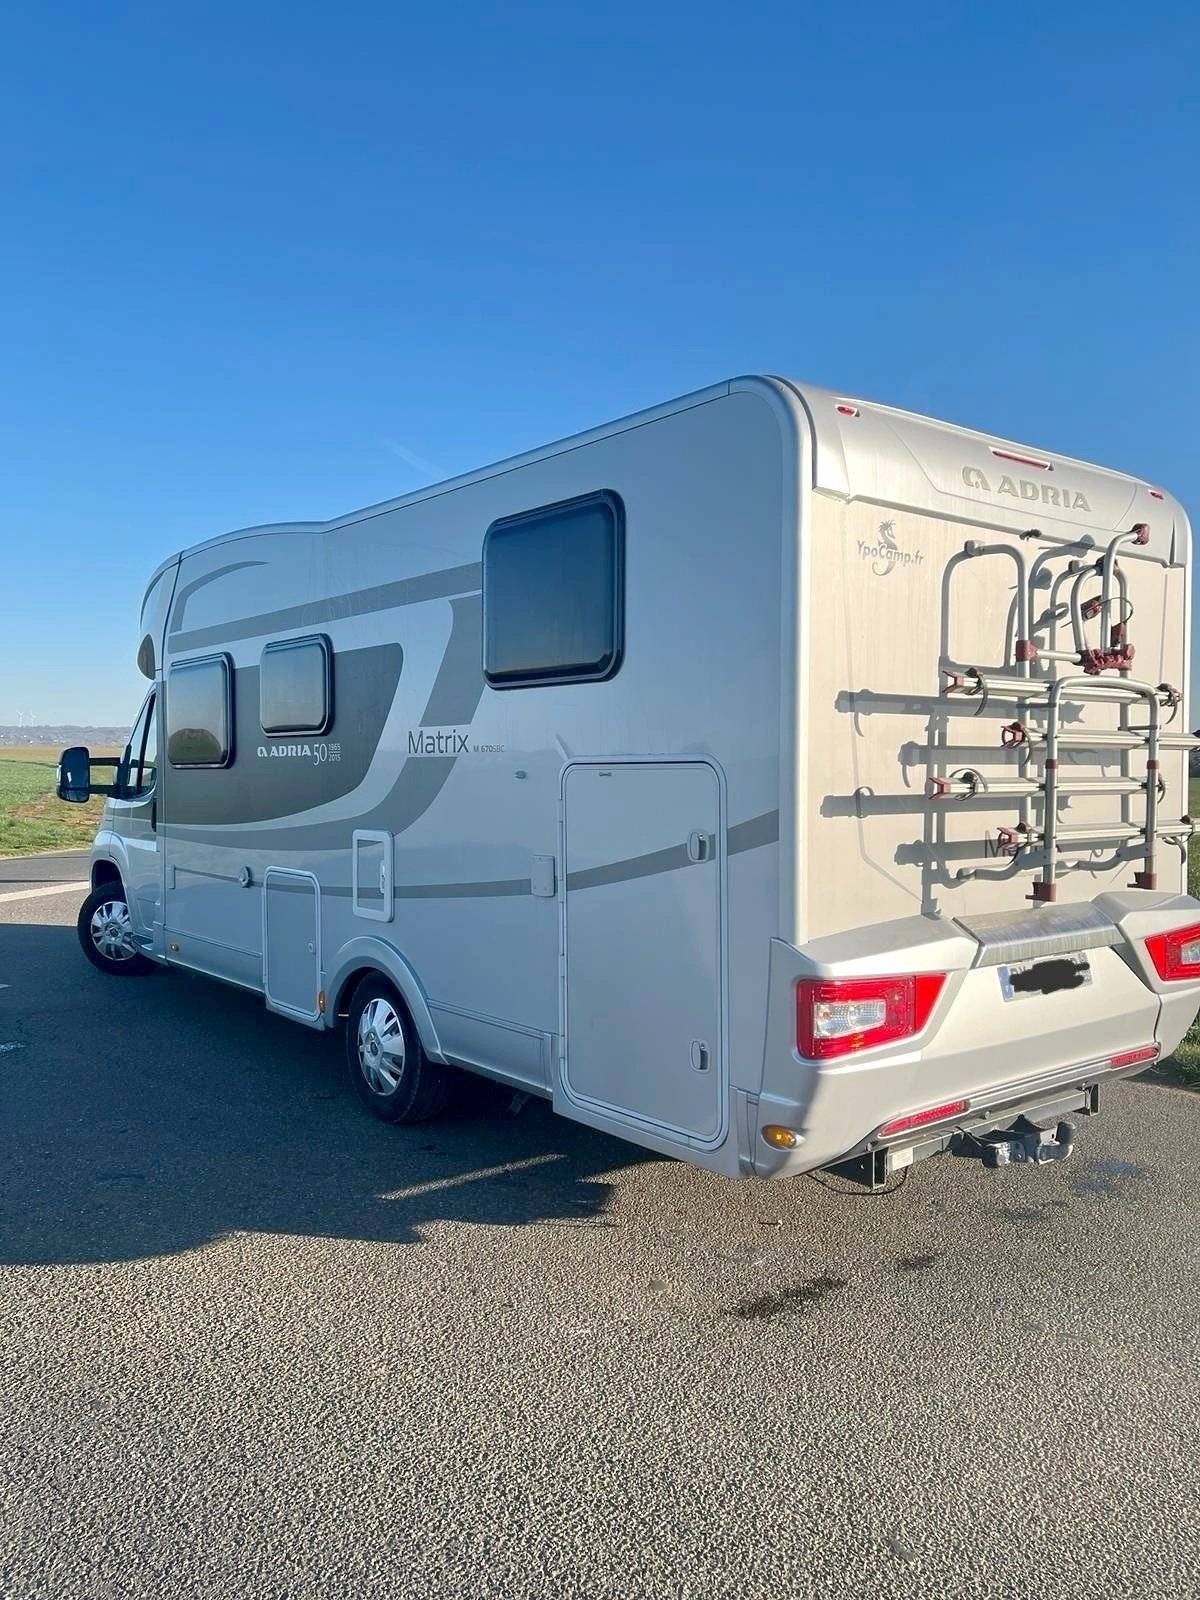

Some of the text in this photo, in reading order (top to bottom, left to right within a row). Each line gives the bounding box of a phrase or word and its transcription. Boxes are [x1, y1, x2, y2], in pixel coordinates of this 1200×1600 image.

[997, 476, 1092, 513] ADRIA
[857, 540, 925, 566] YpoCamp.fr
[408, 729, 469, 754] Matrix
[270, 743, 328, 766] ADRIA 50
[328, 753, 341, 762] 2015
